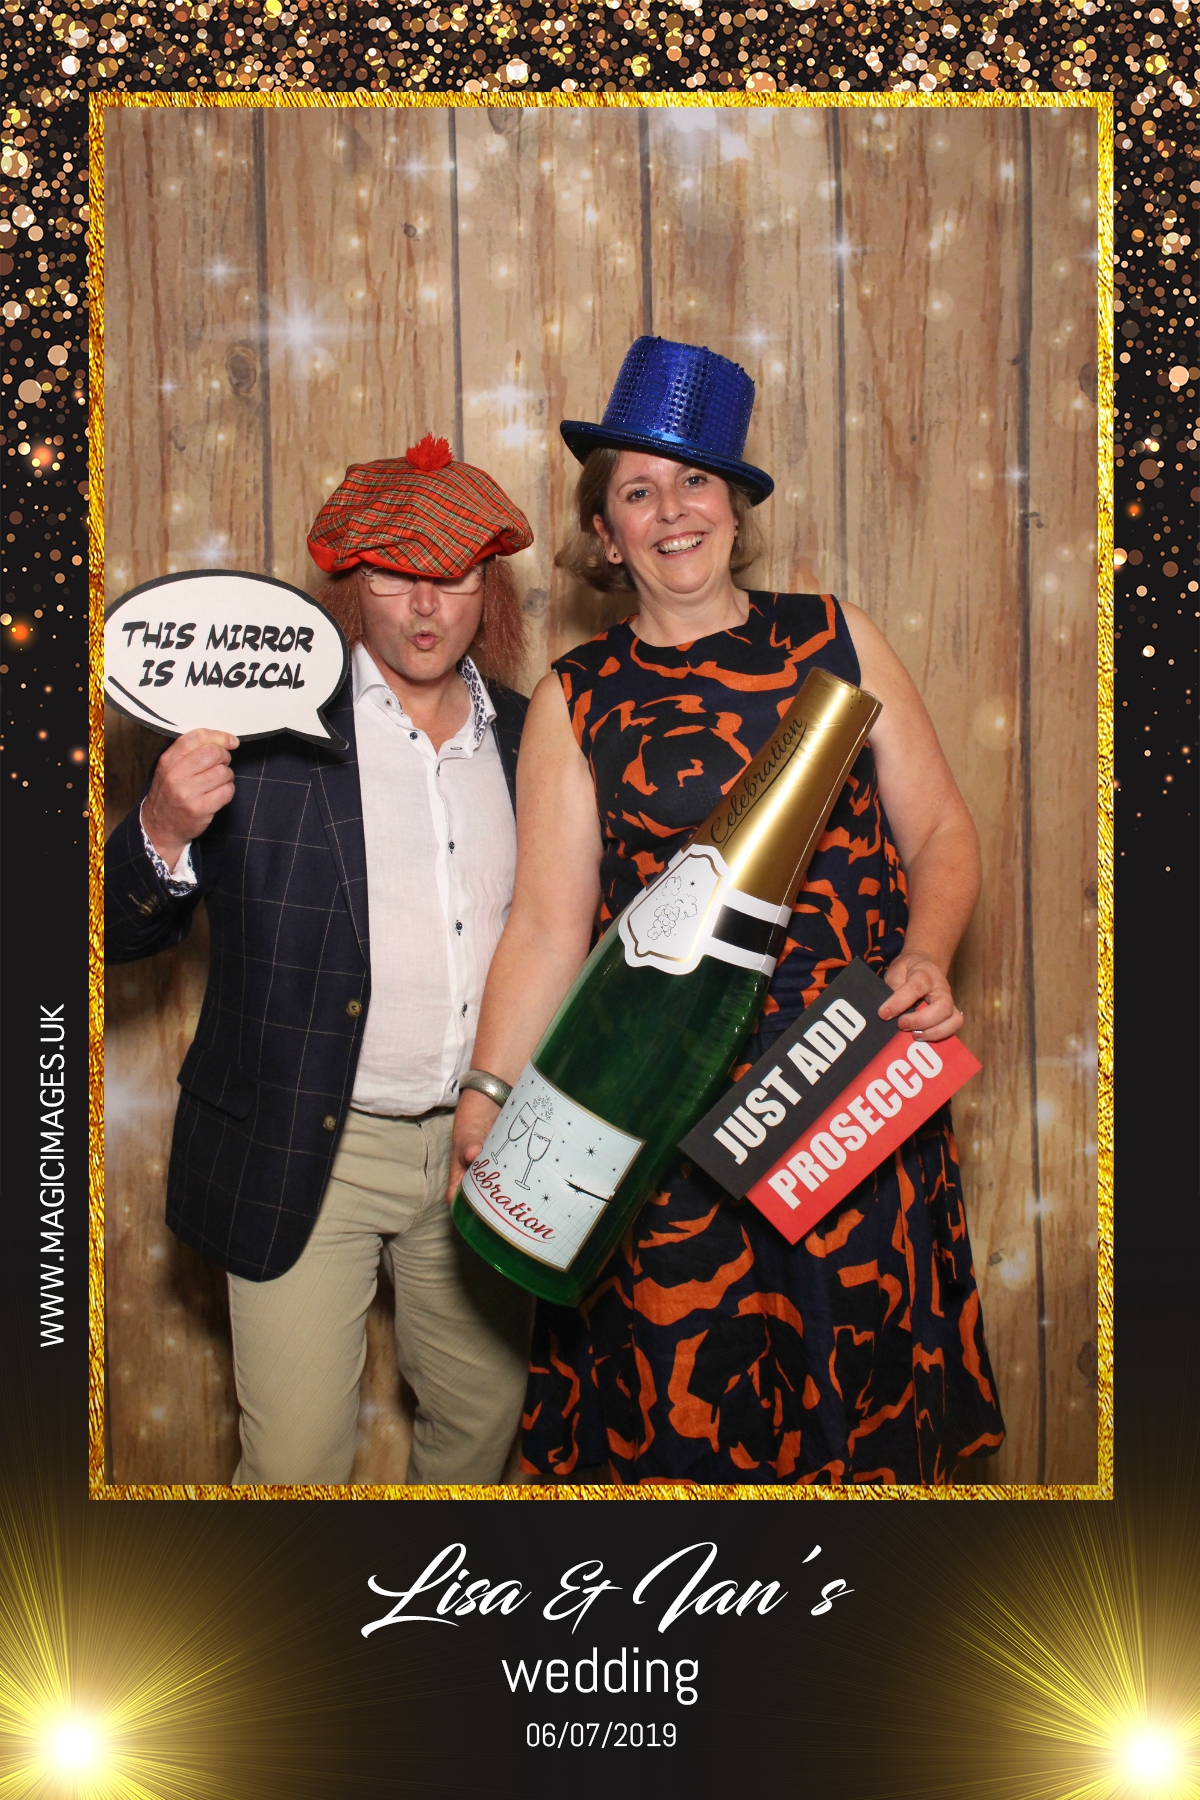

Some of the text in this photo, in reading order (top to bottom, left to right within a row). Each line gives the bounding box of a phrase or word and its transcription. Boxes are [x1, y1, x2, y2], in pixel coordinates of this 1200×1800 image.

[122, 621, 314, 653] THIS MIRROR
[138, 659, 305, 689] IS MAGICAL
[710, 717, 803, 844] Celebration
[713, 998, 867, 1165] JUST ADD
[767, 1041, 943, 1210] PROSECCO
[471, 1158, 556, 1240] elebration
